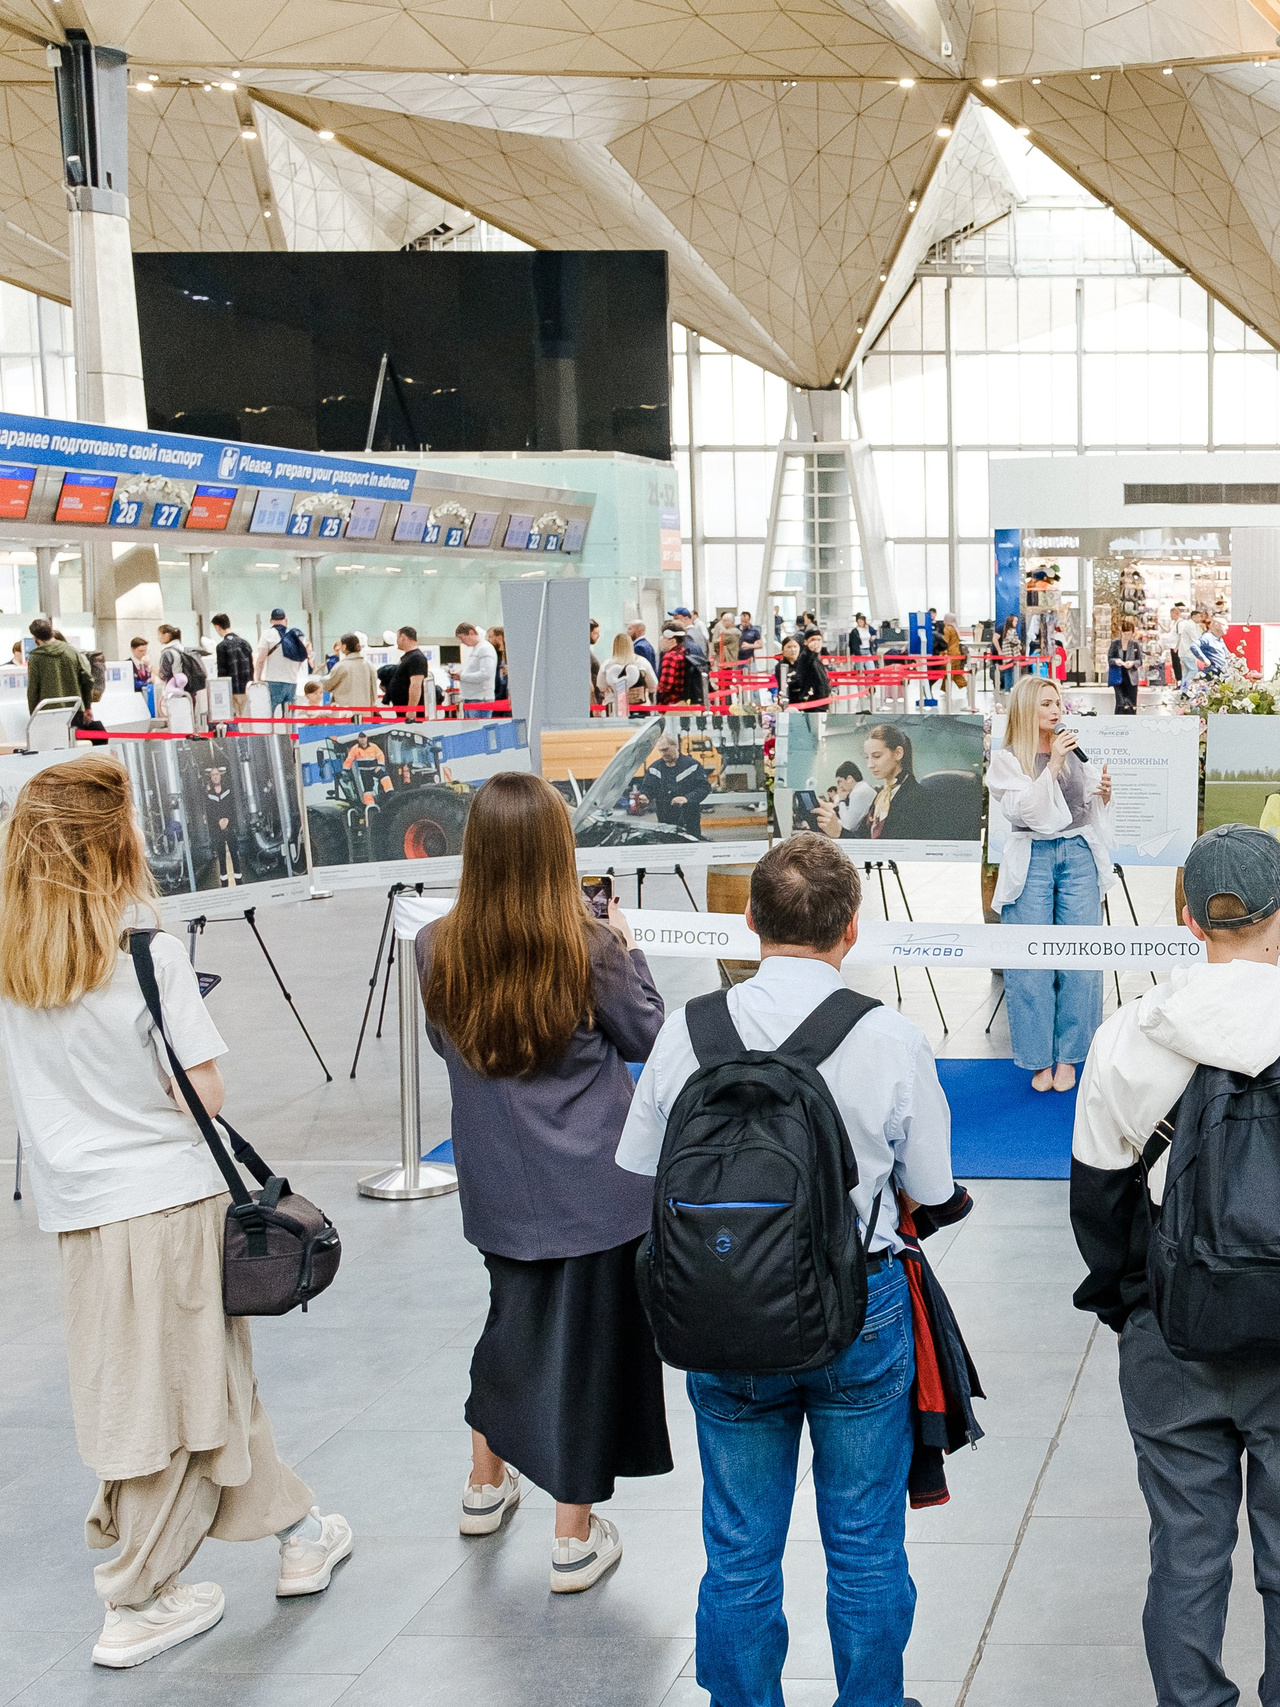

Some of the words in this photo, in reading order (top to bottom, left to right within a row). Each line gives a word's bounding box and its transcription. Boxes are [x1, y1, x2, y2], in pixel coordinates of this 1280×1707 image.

[0, 429, 49, 450] аранее
[51, 435, 127, 458] подготовьте
[129, 443, 158, 462] свой
[158, 449, 204, 470] паспорт
[240, 455, 273, 477] Please,
[275, 462, 312, 480] prepare
[311, 466, 333, 483] your
[332, 469, 369, 488] passport
[369, 471, 378, 486] in
[378, 473, 410, 491] advance
[116, 501, 138, 524] 28
[157, 505, 179, 526] 27
[291, 516, 309, 535] 26
[323, 518, 340, 536] 25
[425, 526, 439, 543] 24
[450, 530, 462, 545] 23
[1112, 748, 1130, 757] тех,
[1107, 757, 1168, 766] возможным
[660, 929, 729, 945] ПРОСТО
[892, 946, 964, 957] ПУЛКОВО
[1028, 942, 1038, 955] С
[1042, 942, 1126, 956] ПУЛКОВО
[1130, 942, 1200, 956] ПРОСТО
